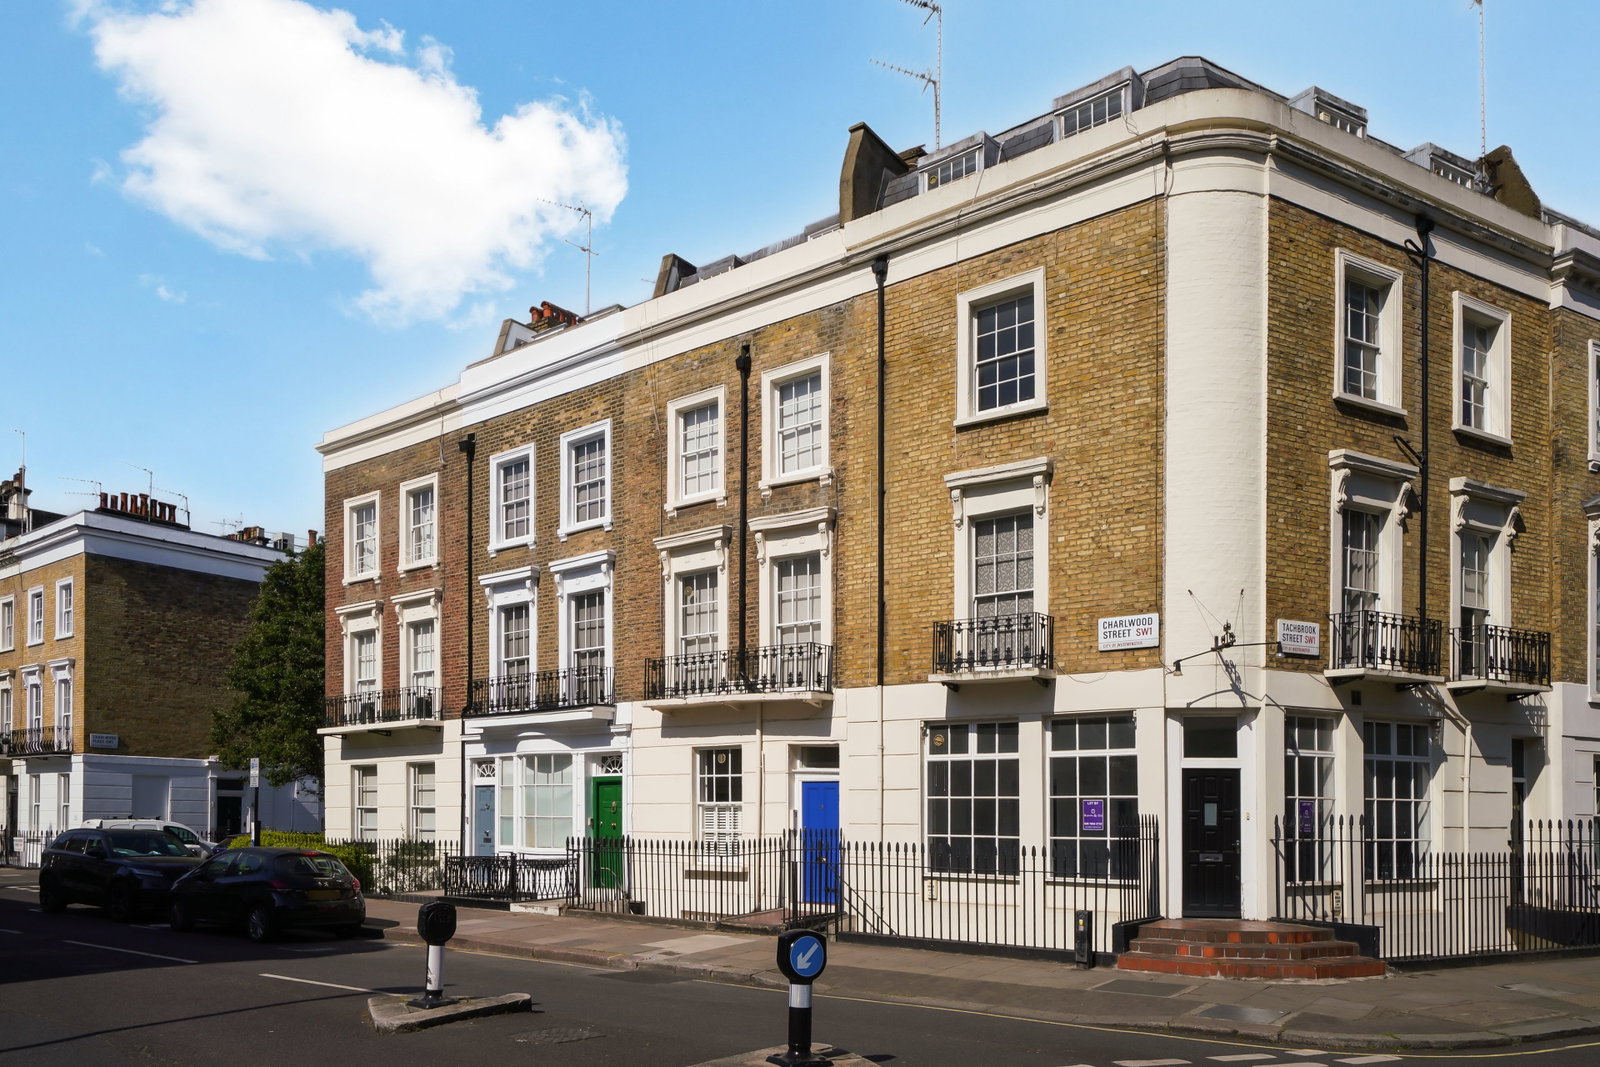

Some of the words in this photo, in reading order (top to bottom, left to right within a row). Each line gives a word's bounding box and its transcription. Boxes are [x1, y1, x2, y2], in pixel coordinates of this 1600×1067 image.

[1102, 617, 1153, 629] CHARLWOOD
[1282, 623, 1316, 635] TACHBROOK
[1103, 629, 1131, 639] STREET
[1136, 627, 1153, 636] SW1
[1282, 633, 1303, 643] STREET
[1304, 635, 1316, 644] SW1
